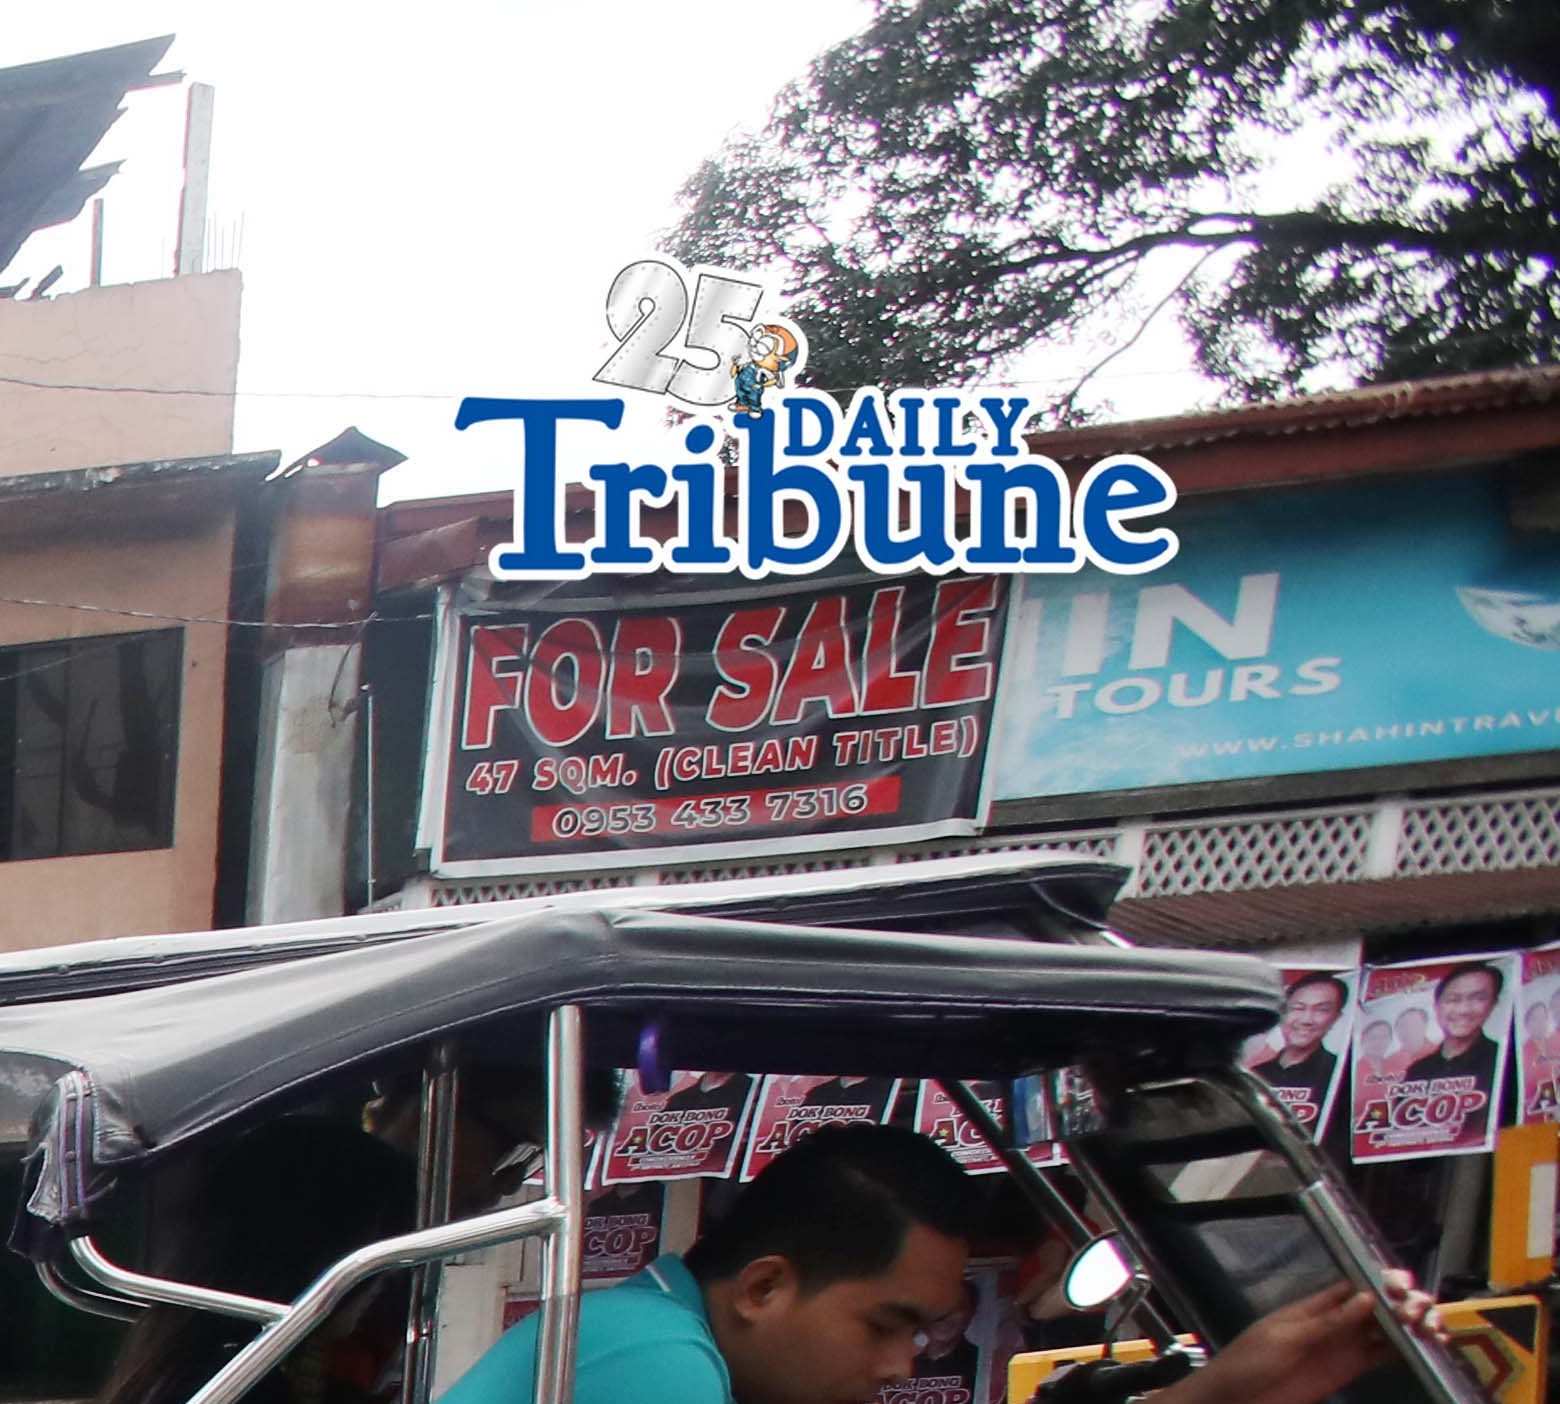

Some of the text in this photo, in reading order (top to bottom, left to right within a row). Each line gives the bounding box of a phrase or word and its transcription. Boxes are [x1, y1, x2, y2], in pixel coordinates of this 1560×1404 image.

[461, 573, 1001, 751] FOR SALE
[1048, 656, 1344, 720] TOURS
[466, 715, 979, 796] 47 SQM. (CLEAN TITLE)
[551, 783, 869, 838] 0953 433 7316
[648, 1107, 729, 1125] DOK BONG
[787, 1104, 870, 1120] DOK BONG
[1355, 1090, 1488, 1131] ACOP
[615, 1121, 735, 1157] ACOP
[583, 1226, 658, 1258] COP
